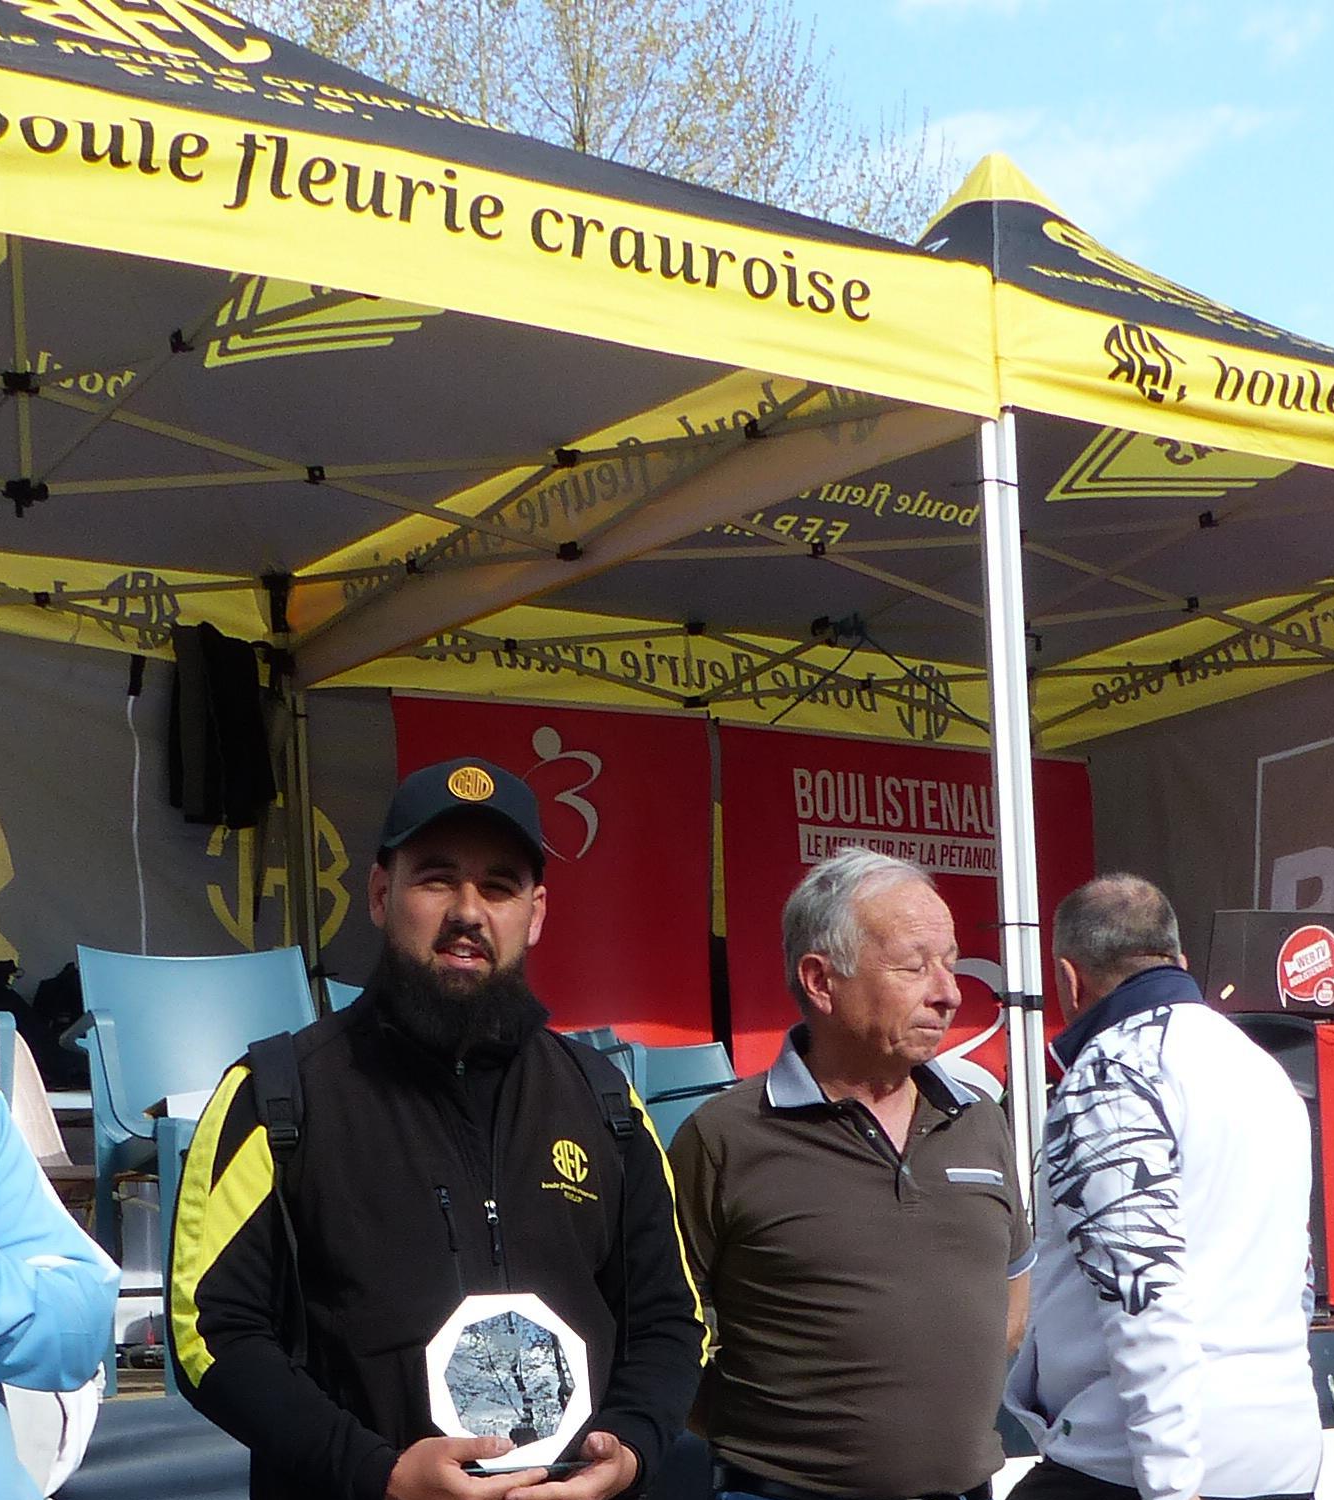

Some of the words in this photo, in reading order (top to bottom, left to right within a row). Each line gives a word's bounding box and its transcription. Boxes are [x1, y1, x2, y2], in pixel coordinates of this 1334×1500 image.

[223, 132, 506, 240] fleurie
[530, 205, 872, 323] crauroise
[793, 767, 995, 835] BOULISTENAU
[806, 833, 822, 857] LE
[919, 842, 936, 866] LA
[940, 838, 997, 871] PÉTANQ
[1296, 951, 1316, 968] WEB
